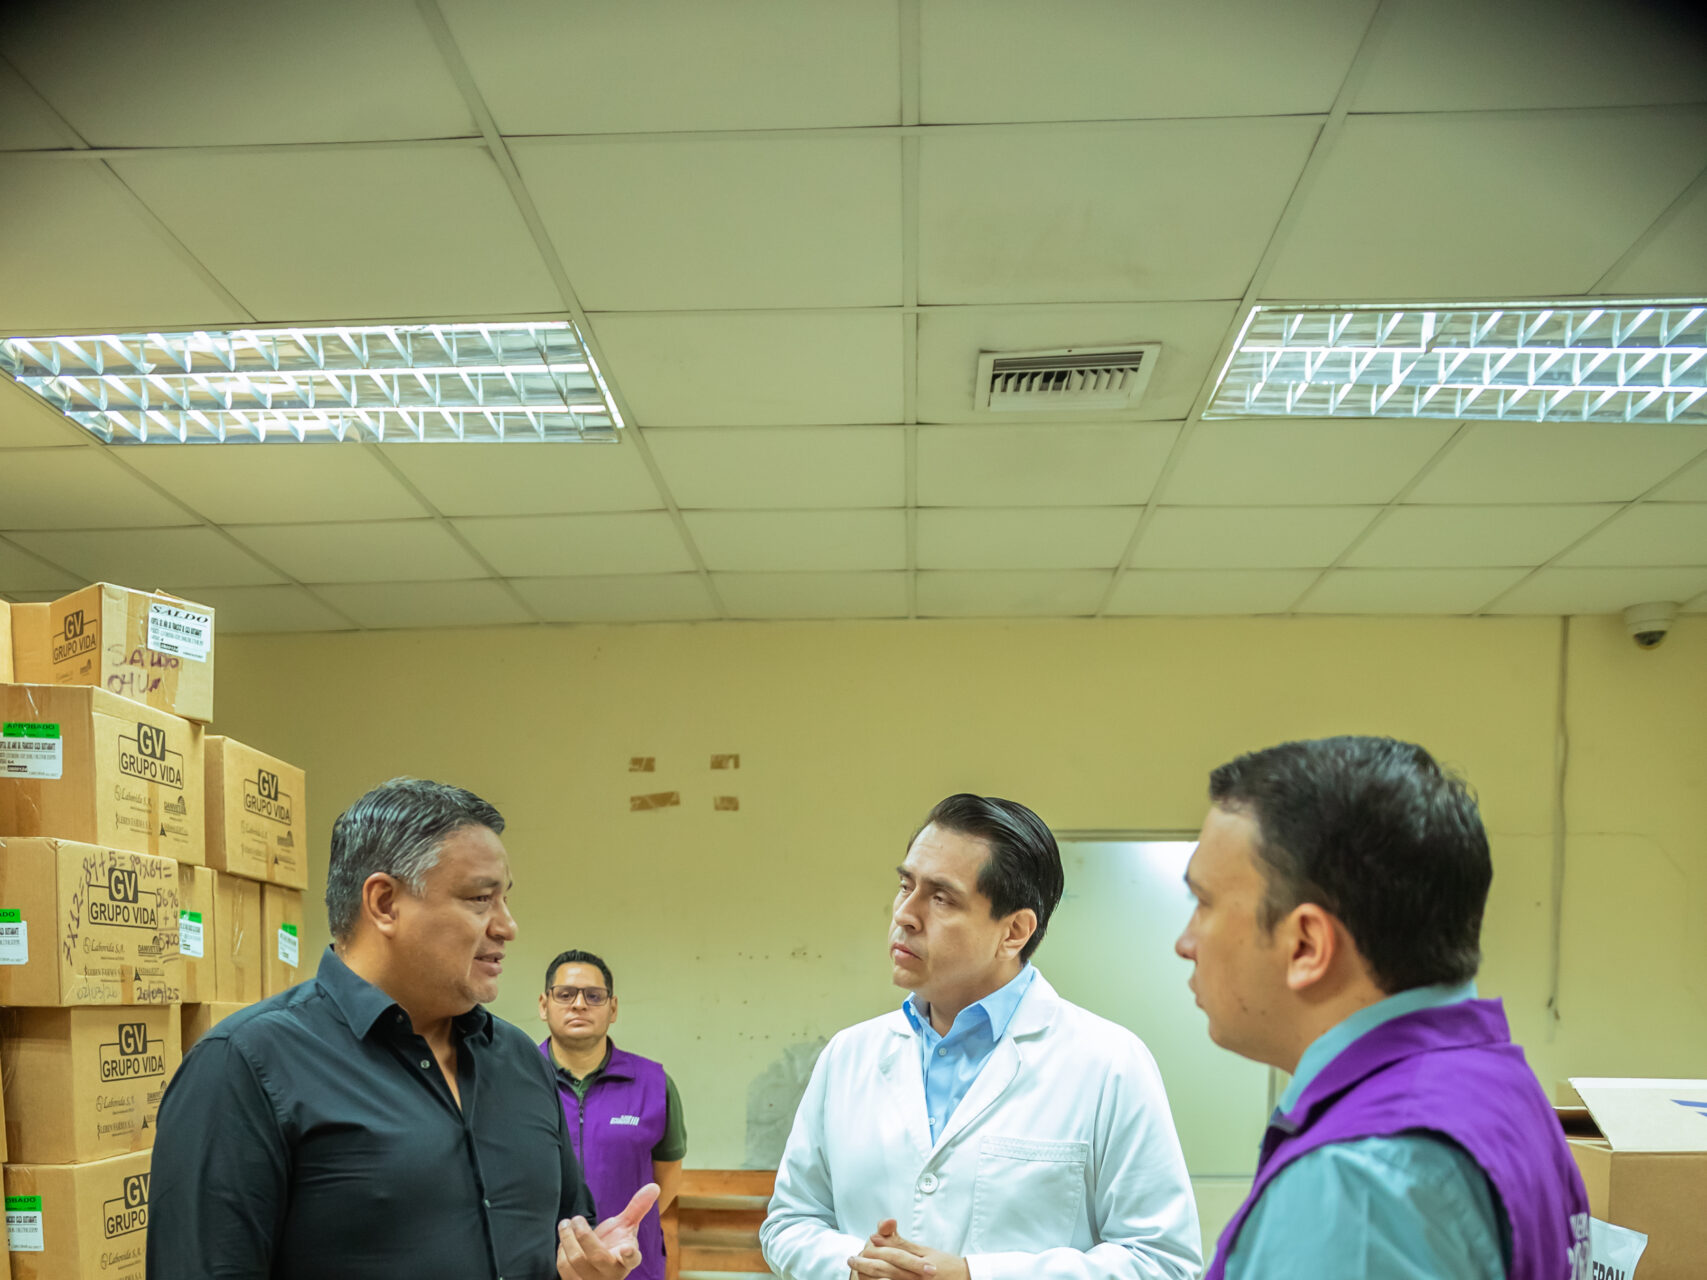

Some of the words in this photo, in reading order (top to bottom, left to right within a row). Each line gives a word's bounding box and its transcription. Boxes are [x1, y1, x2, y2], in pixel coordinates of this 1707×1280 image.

[65, 611, 84, 640] GV
[153, 606, 208, 623] SALDO
[54, 641, 78, 661] GRUPO
[80, 633, 97, 653] VIDA
[139, 724, 164, 760] GV
[121, 752, 158, 778] GRUPO
[159, 763, 182, 786] VIDA
[259, 772, 278, 800] GV
[246, 793, 272, 815] GRUPO
[273, 803, 290, 820] VIDA
[110, 869, 136, 901] GV
[90, 902, 130, 923] GRUPO
[133, 907, 157, 925] VIDA
[120, 1024, 145, 1054] GV
[103, 1058, 140, 1078] GRUPO
[142, 1055, 164, 1073] VIDA
[126, 1174, 150, 1206] GV
[106, 1208, 146, 1235] GRUPO
